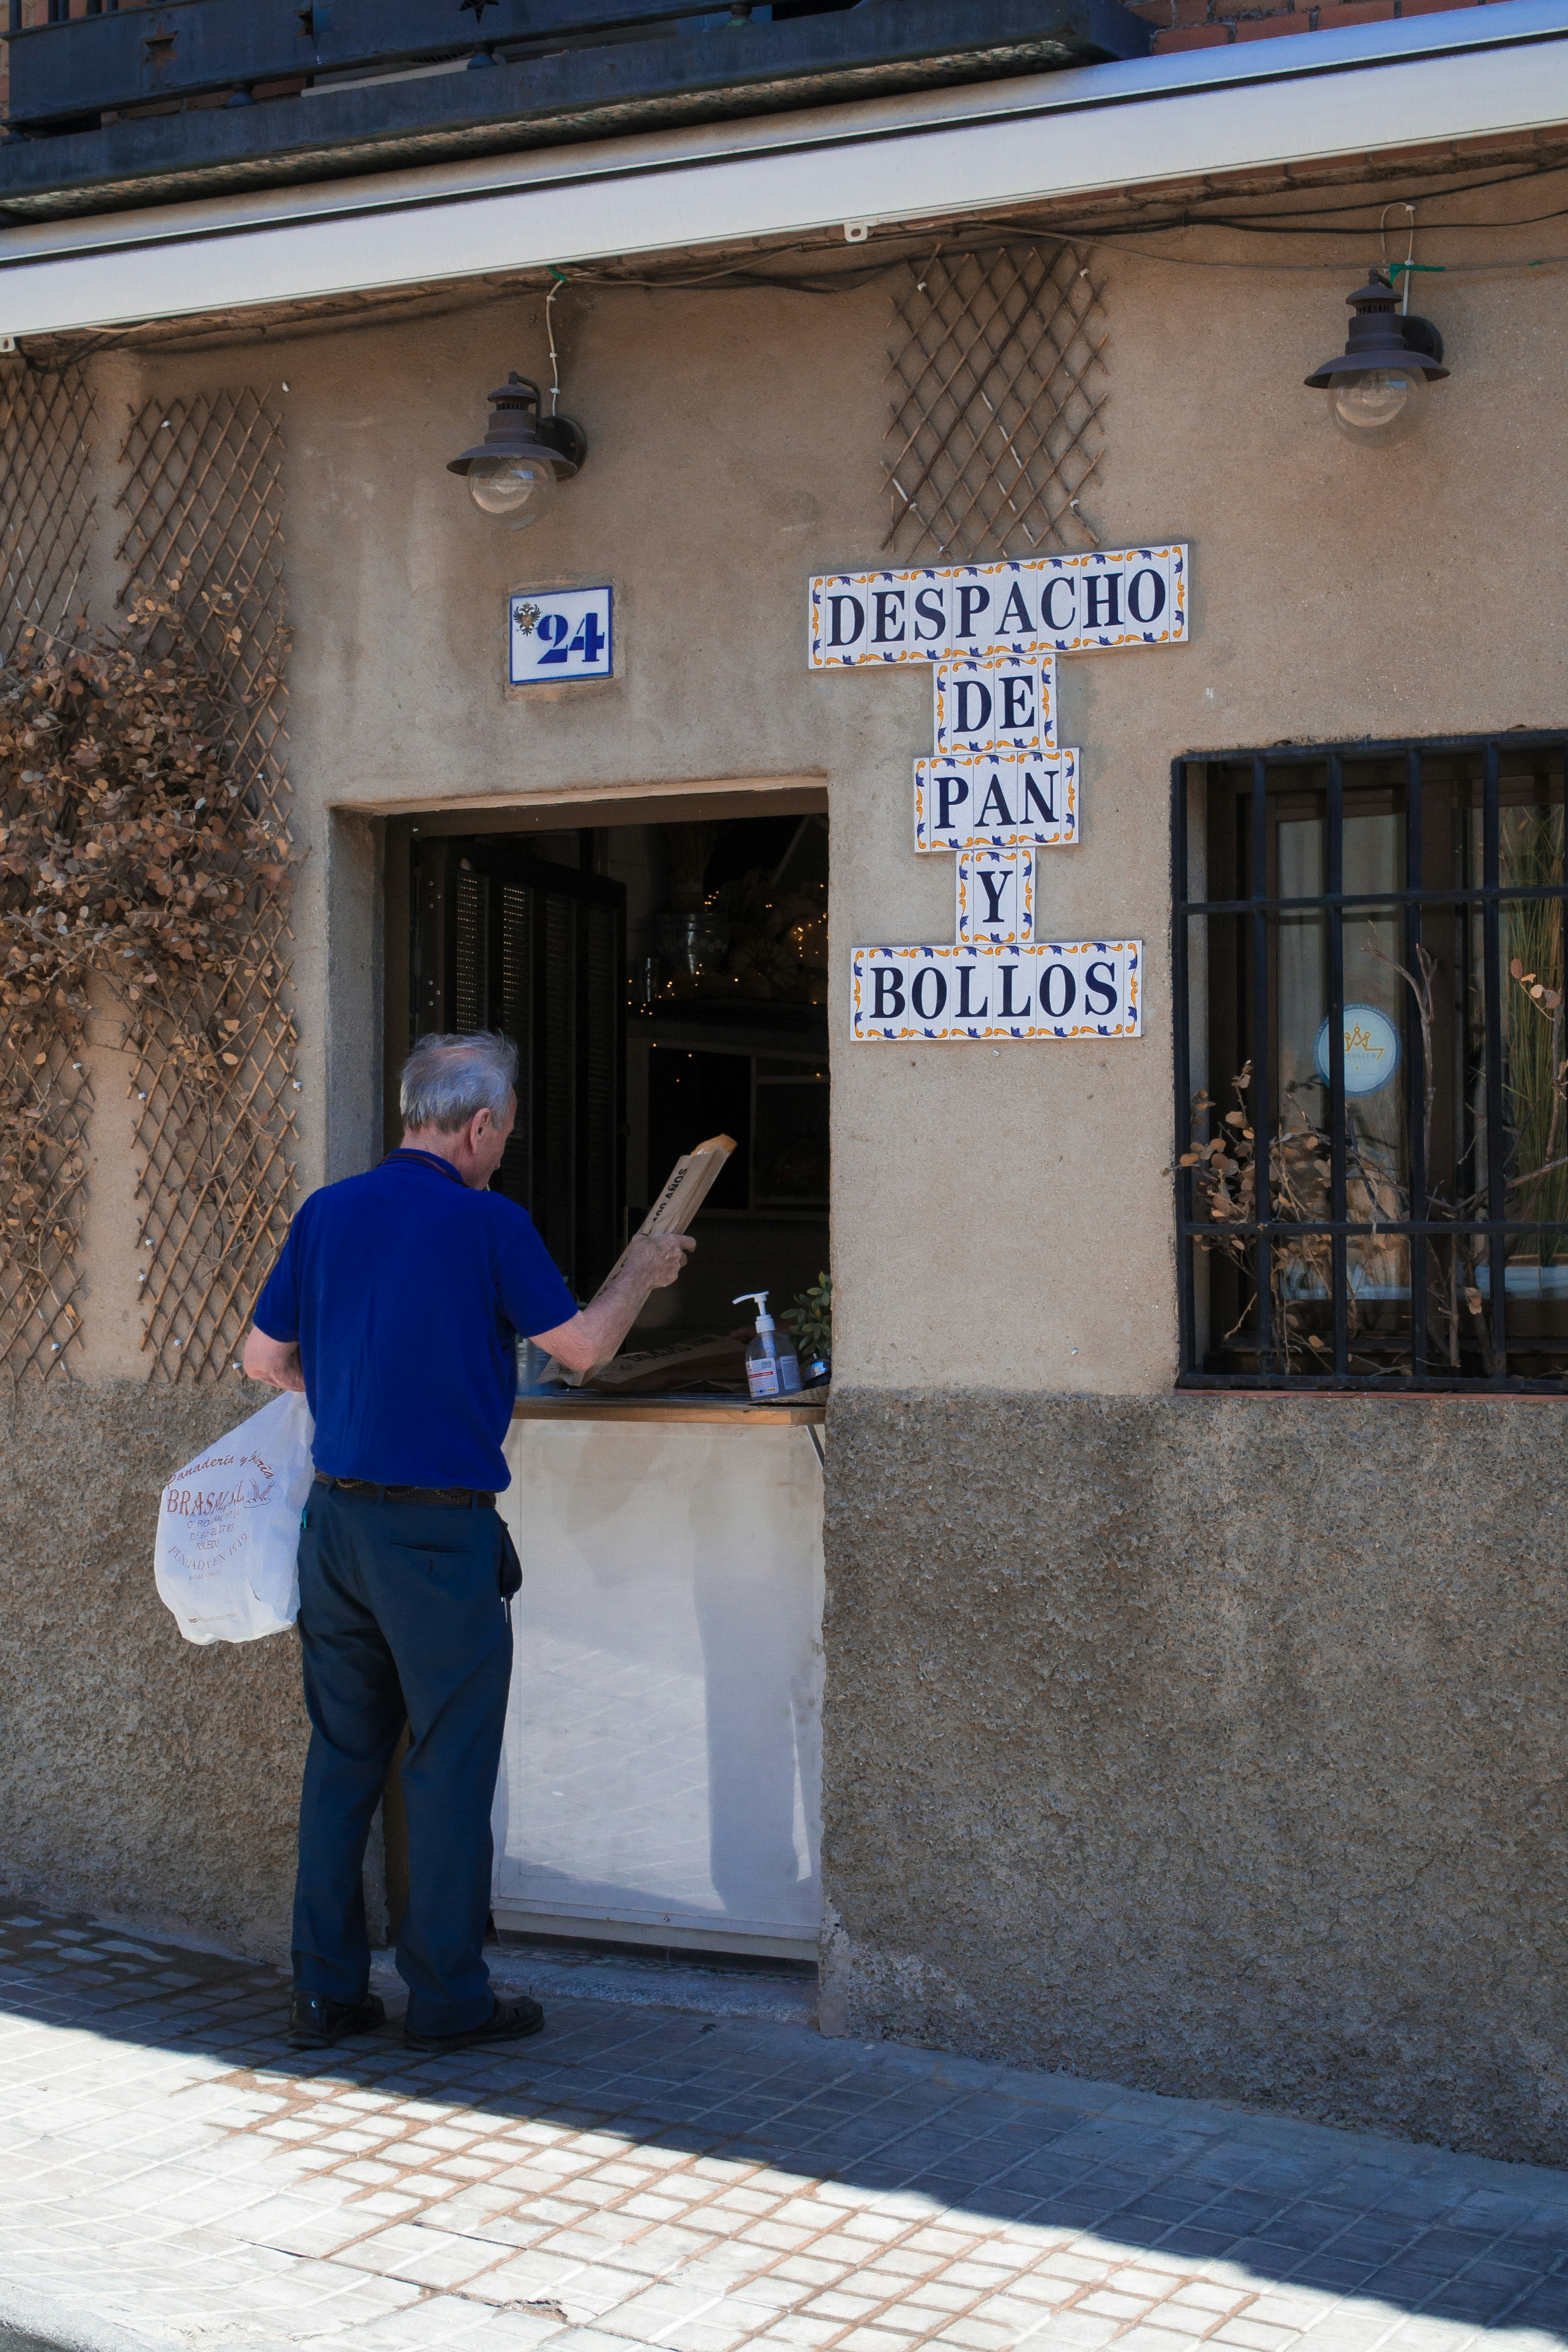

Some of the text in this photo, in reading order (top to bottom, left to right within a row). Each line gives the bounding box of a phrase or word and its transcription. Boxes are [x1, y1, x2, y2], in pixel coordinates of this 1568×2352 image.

[827, 569, 1166, 647] DESPACHO
[536, 612, 605, 664] 24
[953, 675, 1035, 733] DE
[934, 770, 1060, 829] PAN
[976, 870, 1012, 923] Y
[869, 962, 1118, 1019] BOLLOS
[1362, 1003, 1396, 1031] COLABORADOR
[665, 1168, 688, 1199] AÑOS
[240, 1455, 248, 1466] y
[167, 1533, 247, 1570] FUNDADA EN 1919
[196, 1538, 219, 1551] TOLEDO
